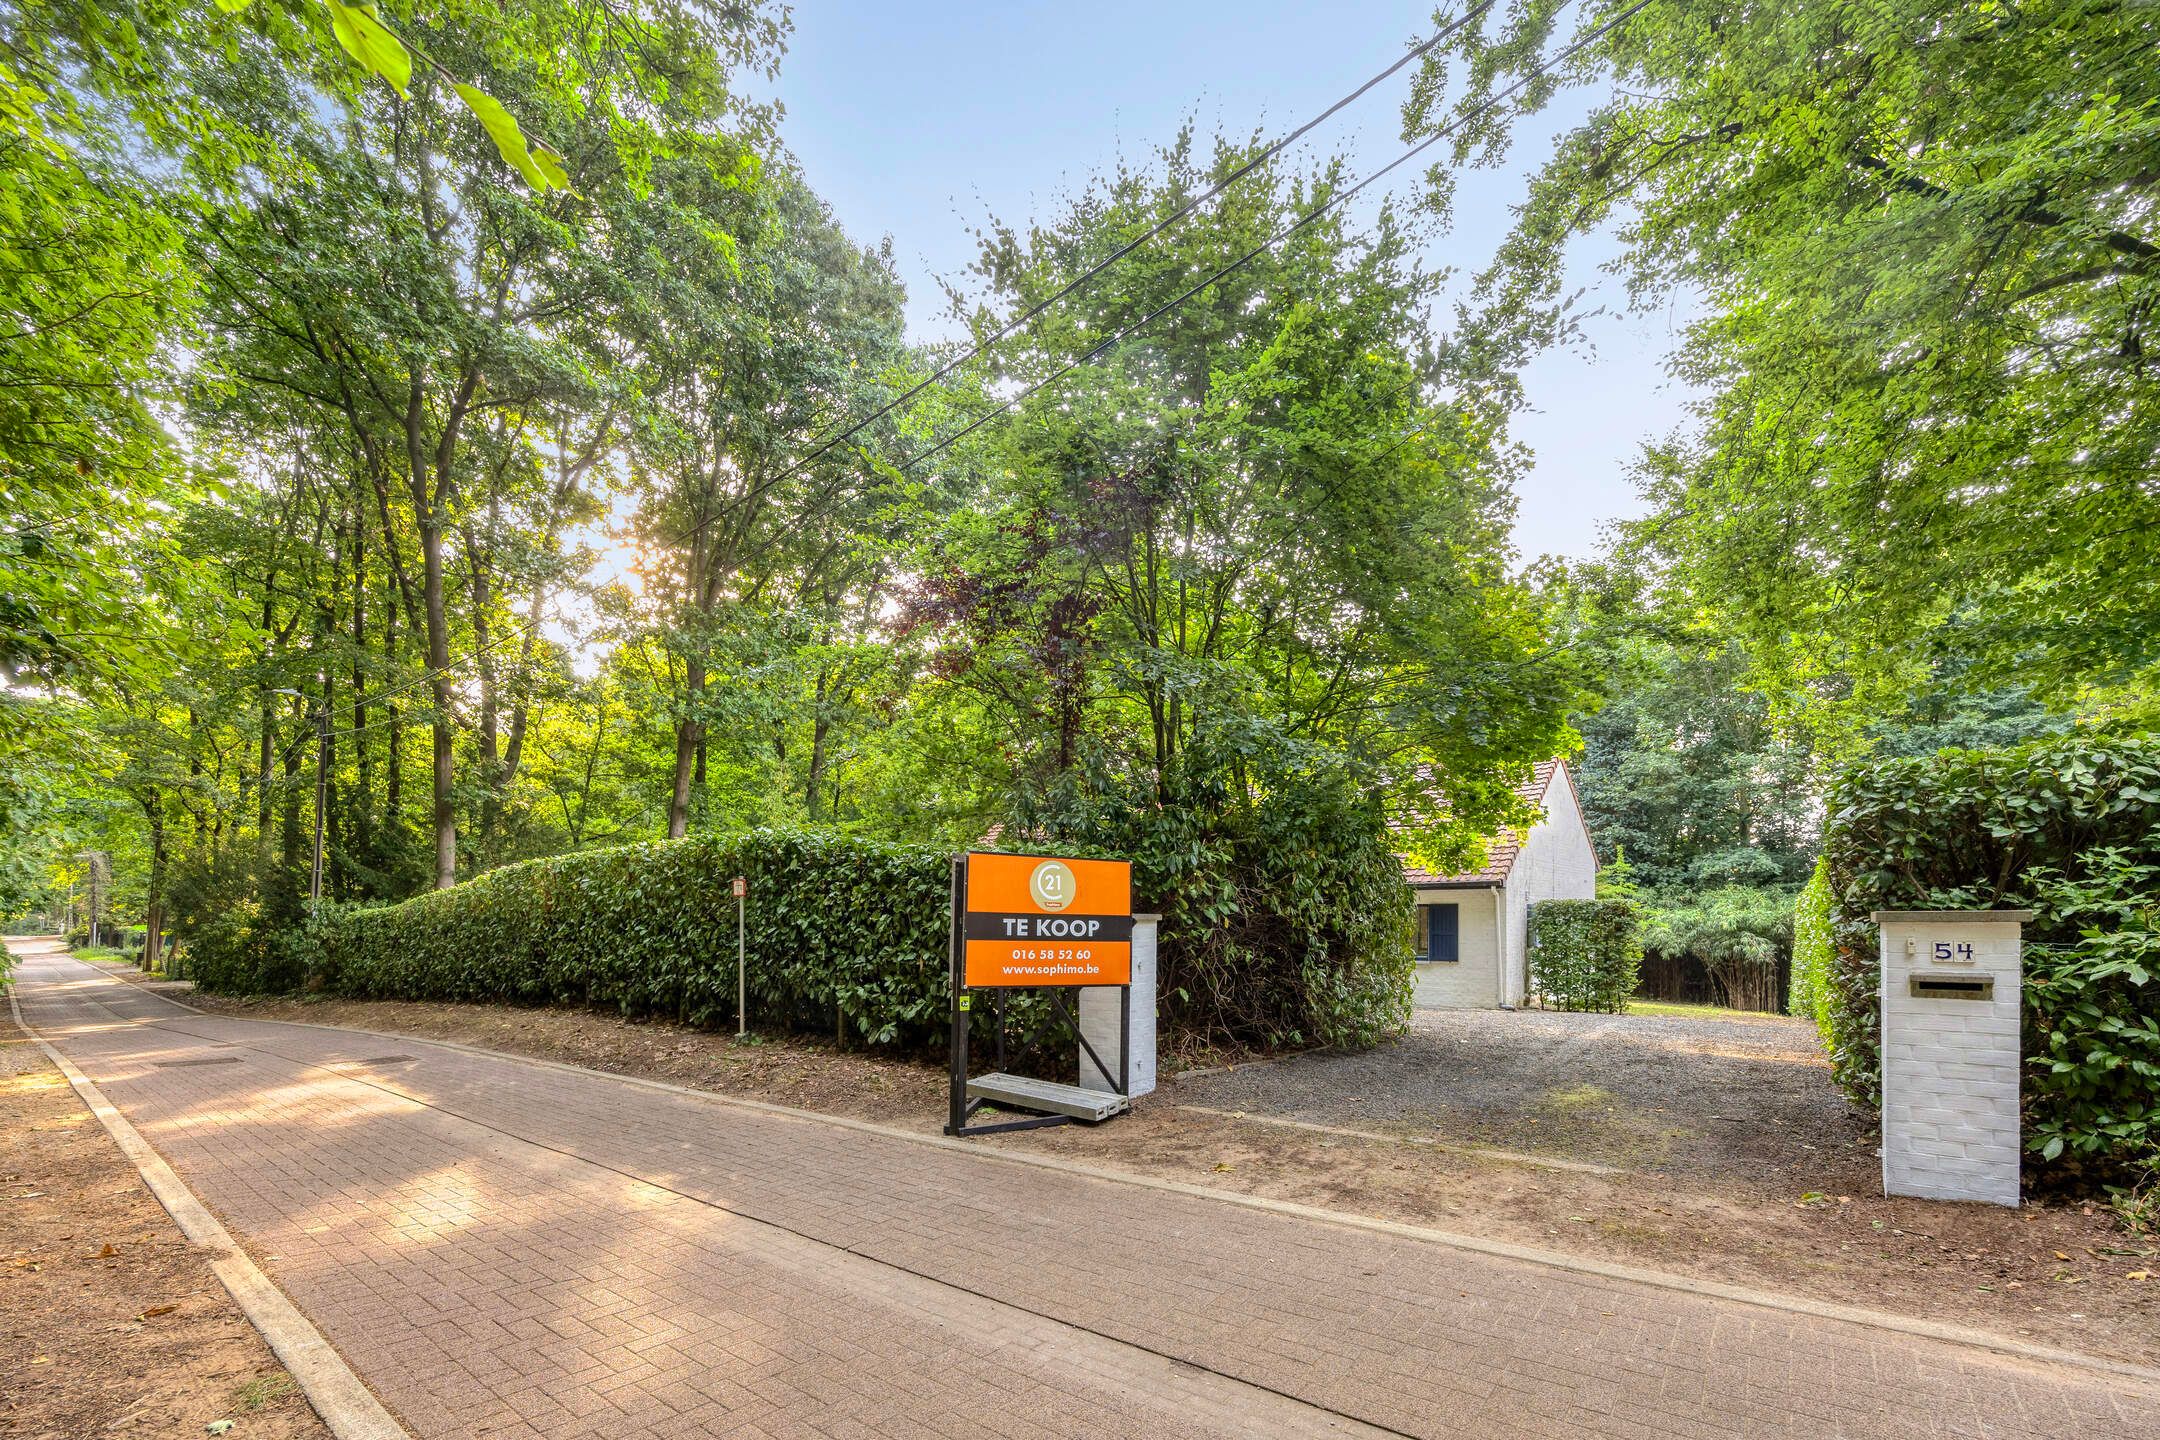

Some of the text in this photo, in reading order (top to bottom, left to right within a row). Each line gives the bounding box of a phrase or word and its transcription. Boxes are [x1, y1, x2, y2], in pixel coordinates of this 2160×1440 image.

[1003, 918, 1100, 937] TE KOOP
[1012, 949, 1091, 960] 016 58 52 60
[1935, 942, 1974, 961] 54
[1002, 963, 1100, 977] www.sophimo.be
